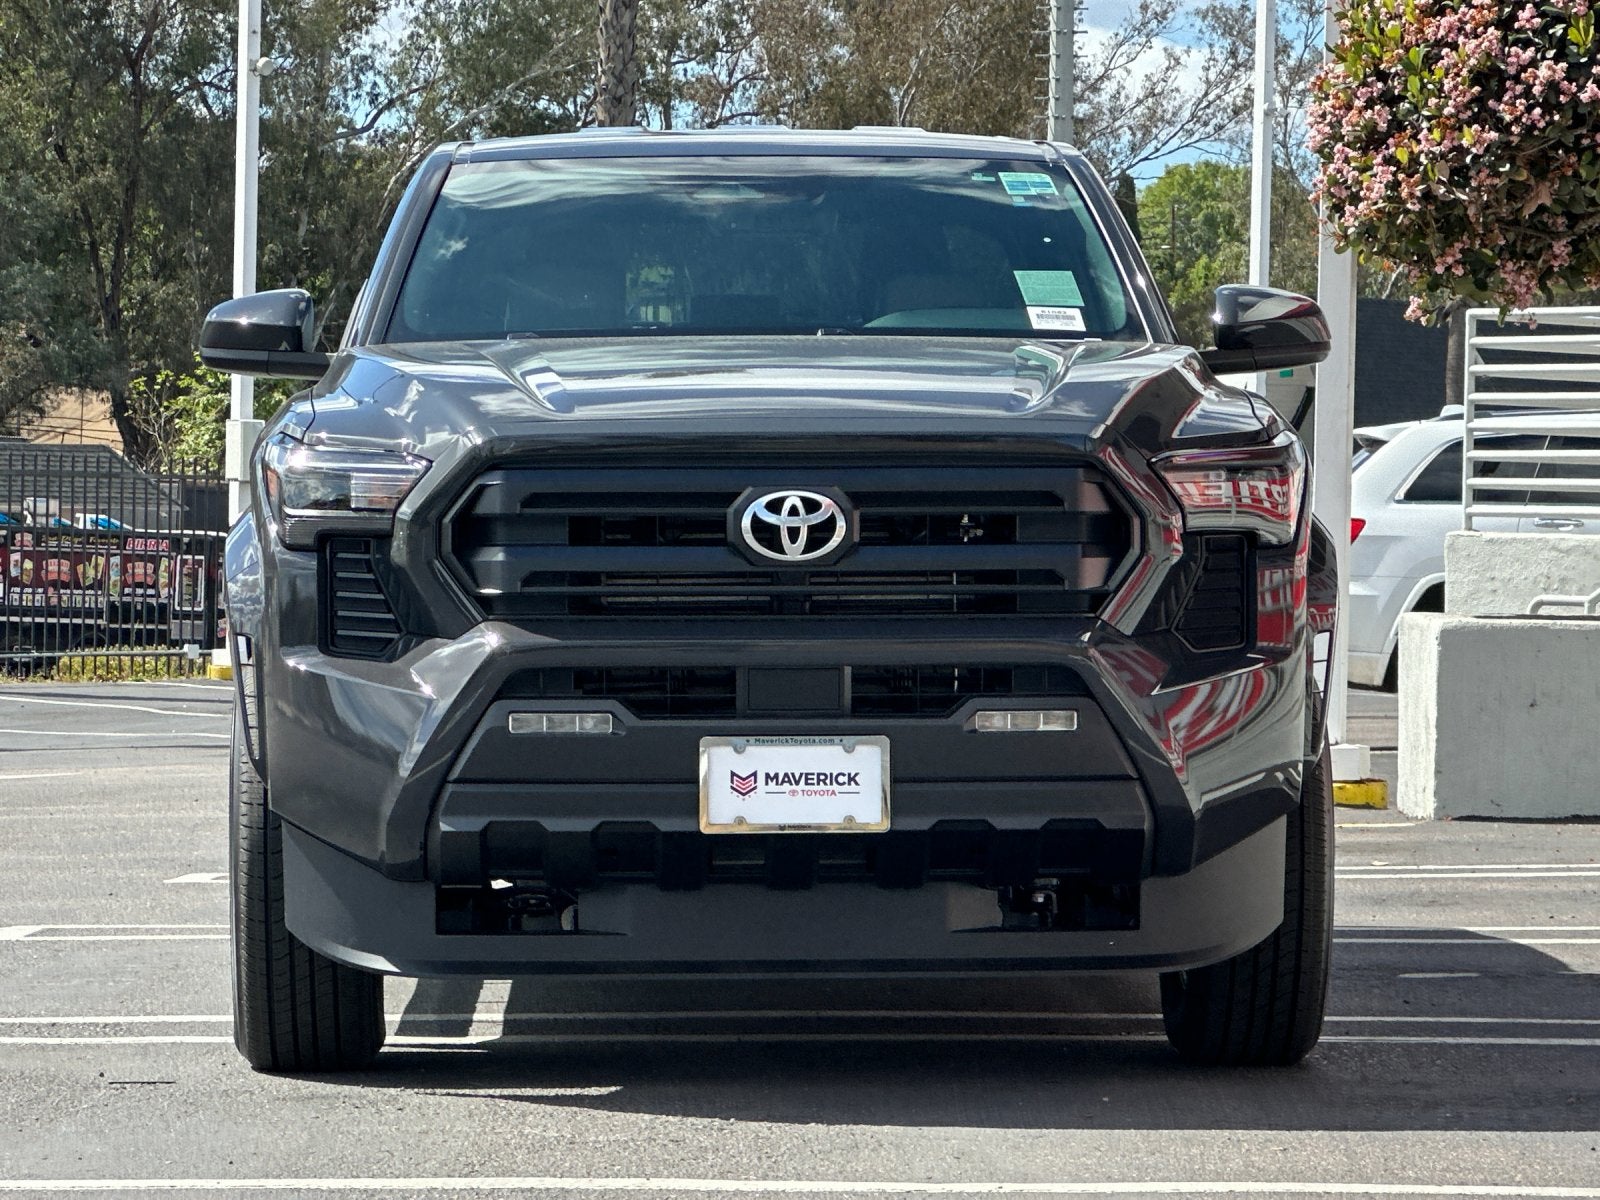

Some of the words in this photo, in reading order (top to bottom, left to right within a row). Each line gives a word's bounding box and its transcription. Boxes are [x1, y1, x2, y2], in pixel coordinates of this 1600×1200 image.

[754, 737, 835, 745] MaverickToyota.com
[764, 772, 860, 786] MAVERICK
[800, 789, 837, 797] TOYOTA
